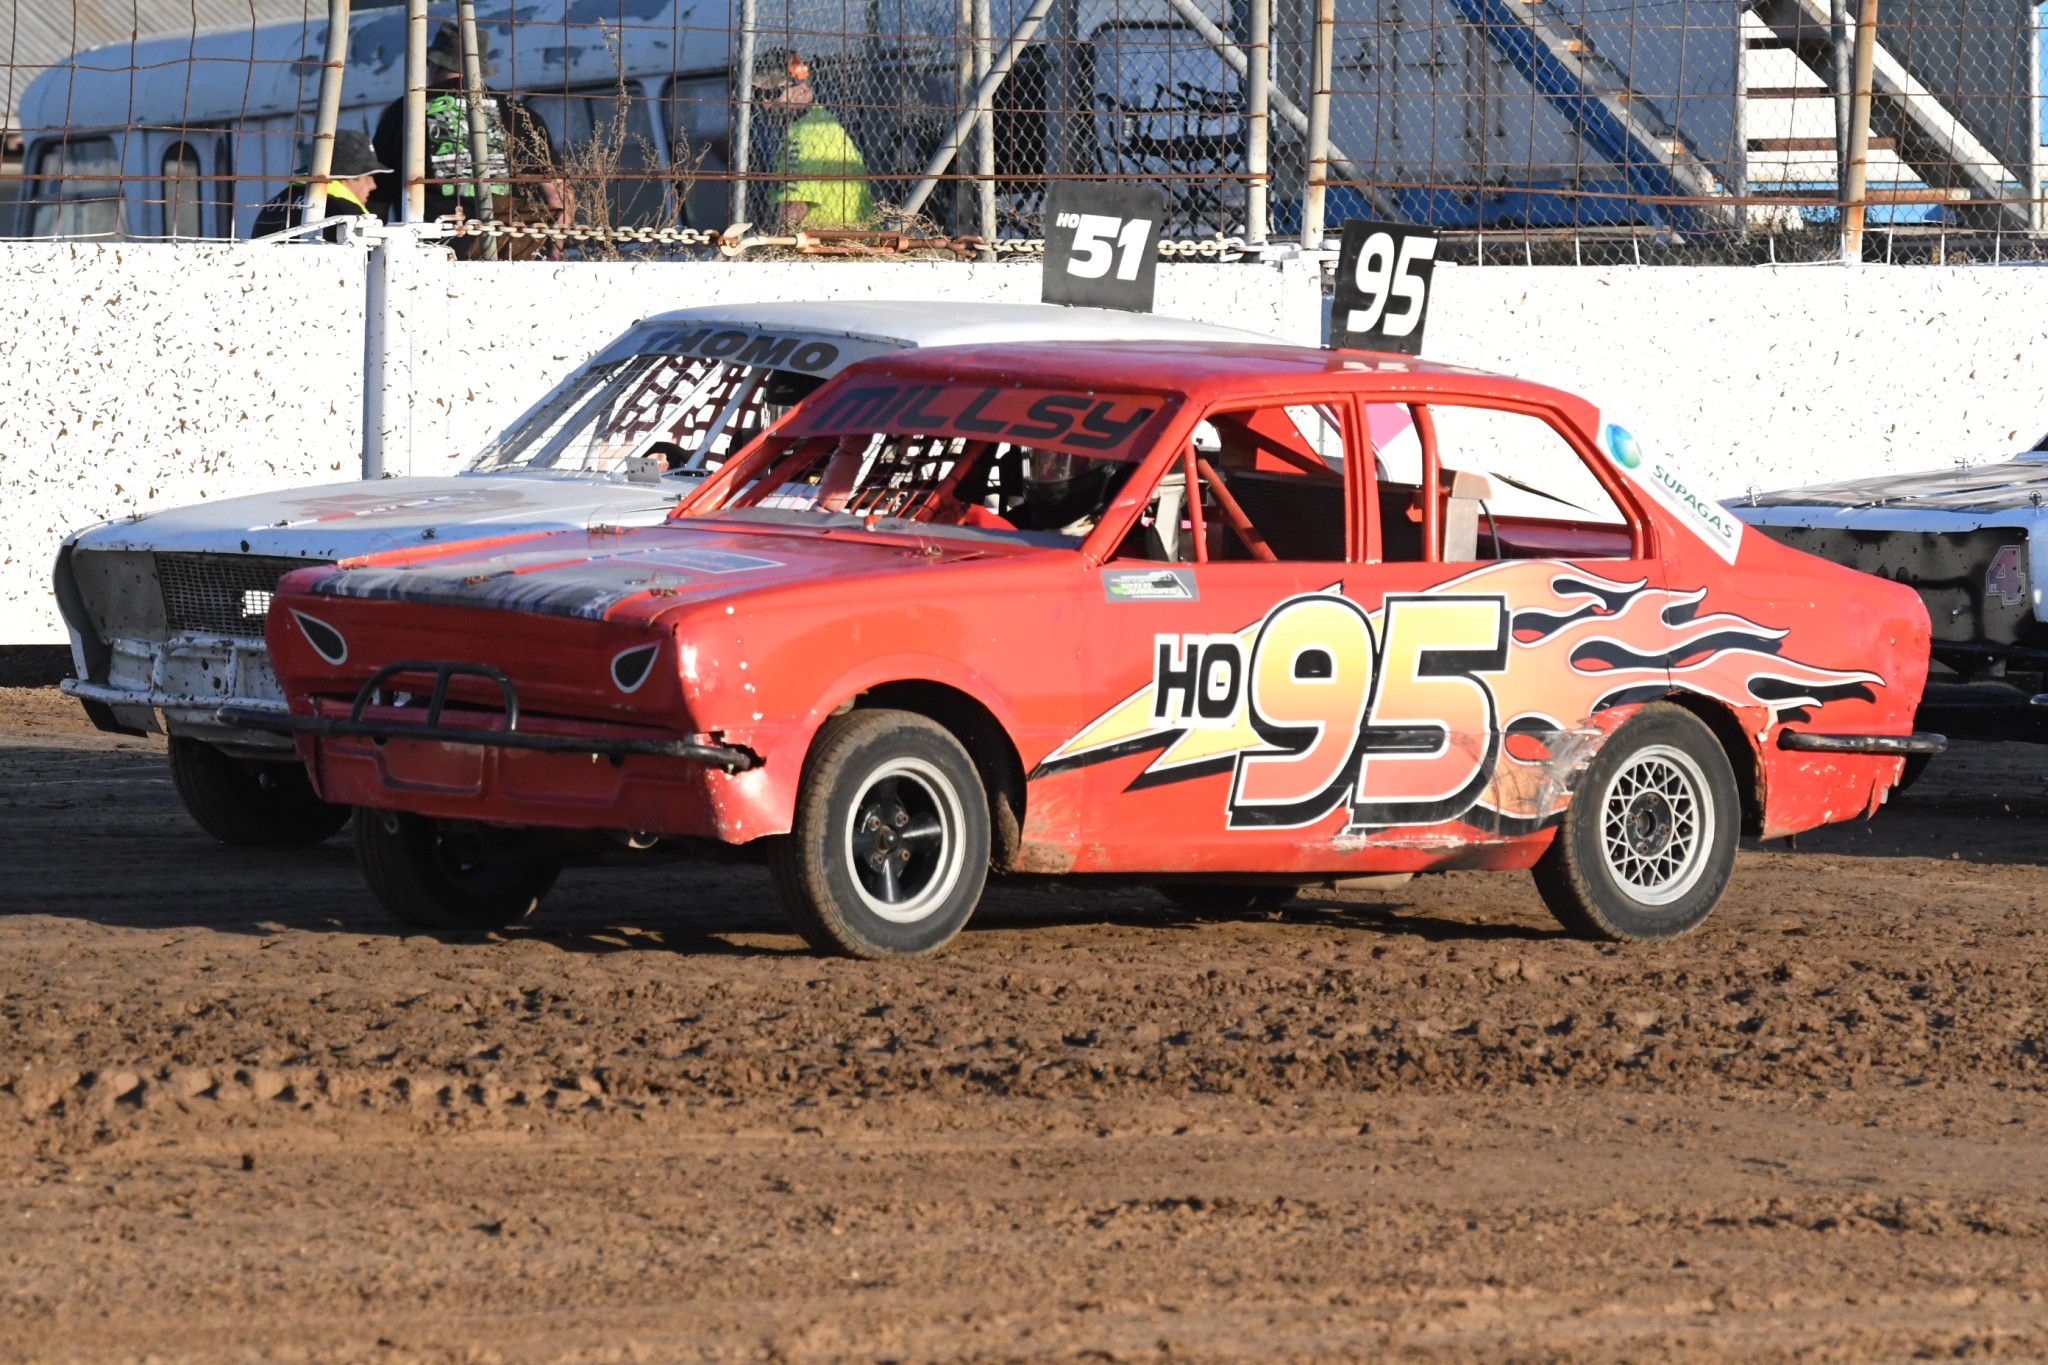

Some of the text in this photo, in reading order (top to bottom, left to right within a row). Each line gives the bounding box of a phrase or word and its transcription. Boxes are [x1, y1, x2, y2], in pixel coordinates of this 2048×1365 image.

[1056, 212, 1152, 281] HO 51
[1347, 232, 1438, 336] 95
[636, 328, 840, 372] THOMO
[808, 384, 1156, 450] MILLSY
[1652, 464, 1735, 539] SUPAGAS
[1986, 545, 2026, 605] 4
[1154, 592, 1512, 830] HO 95
